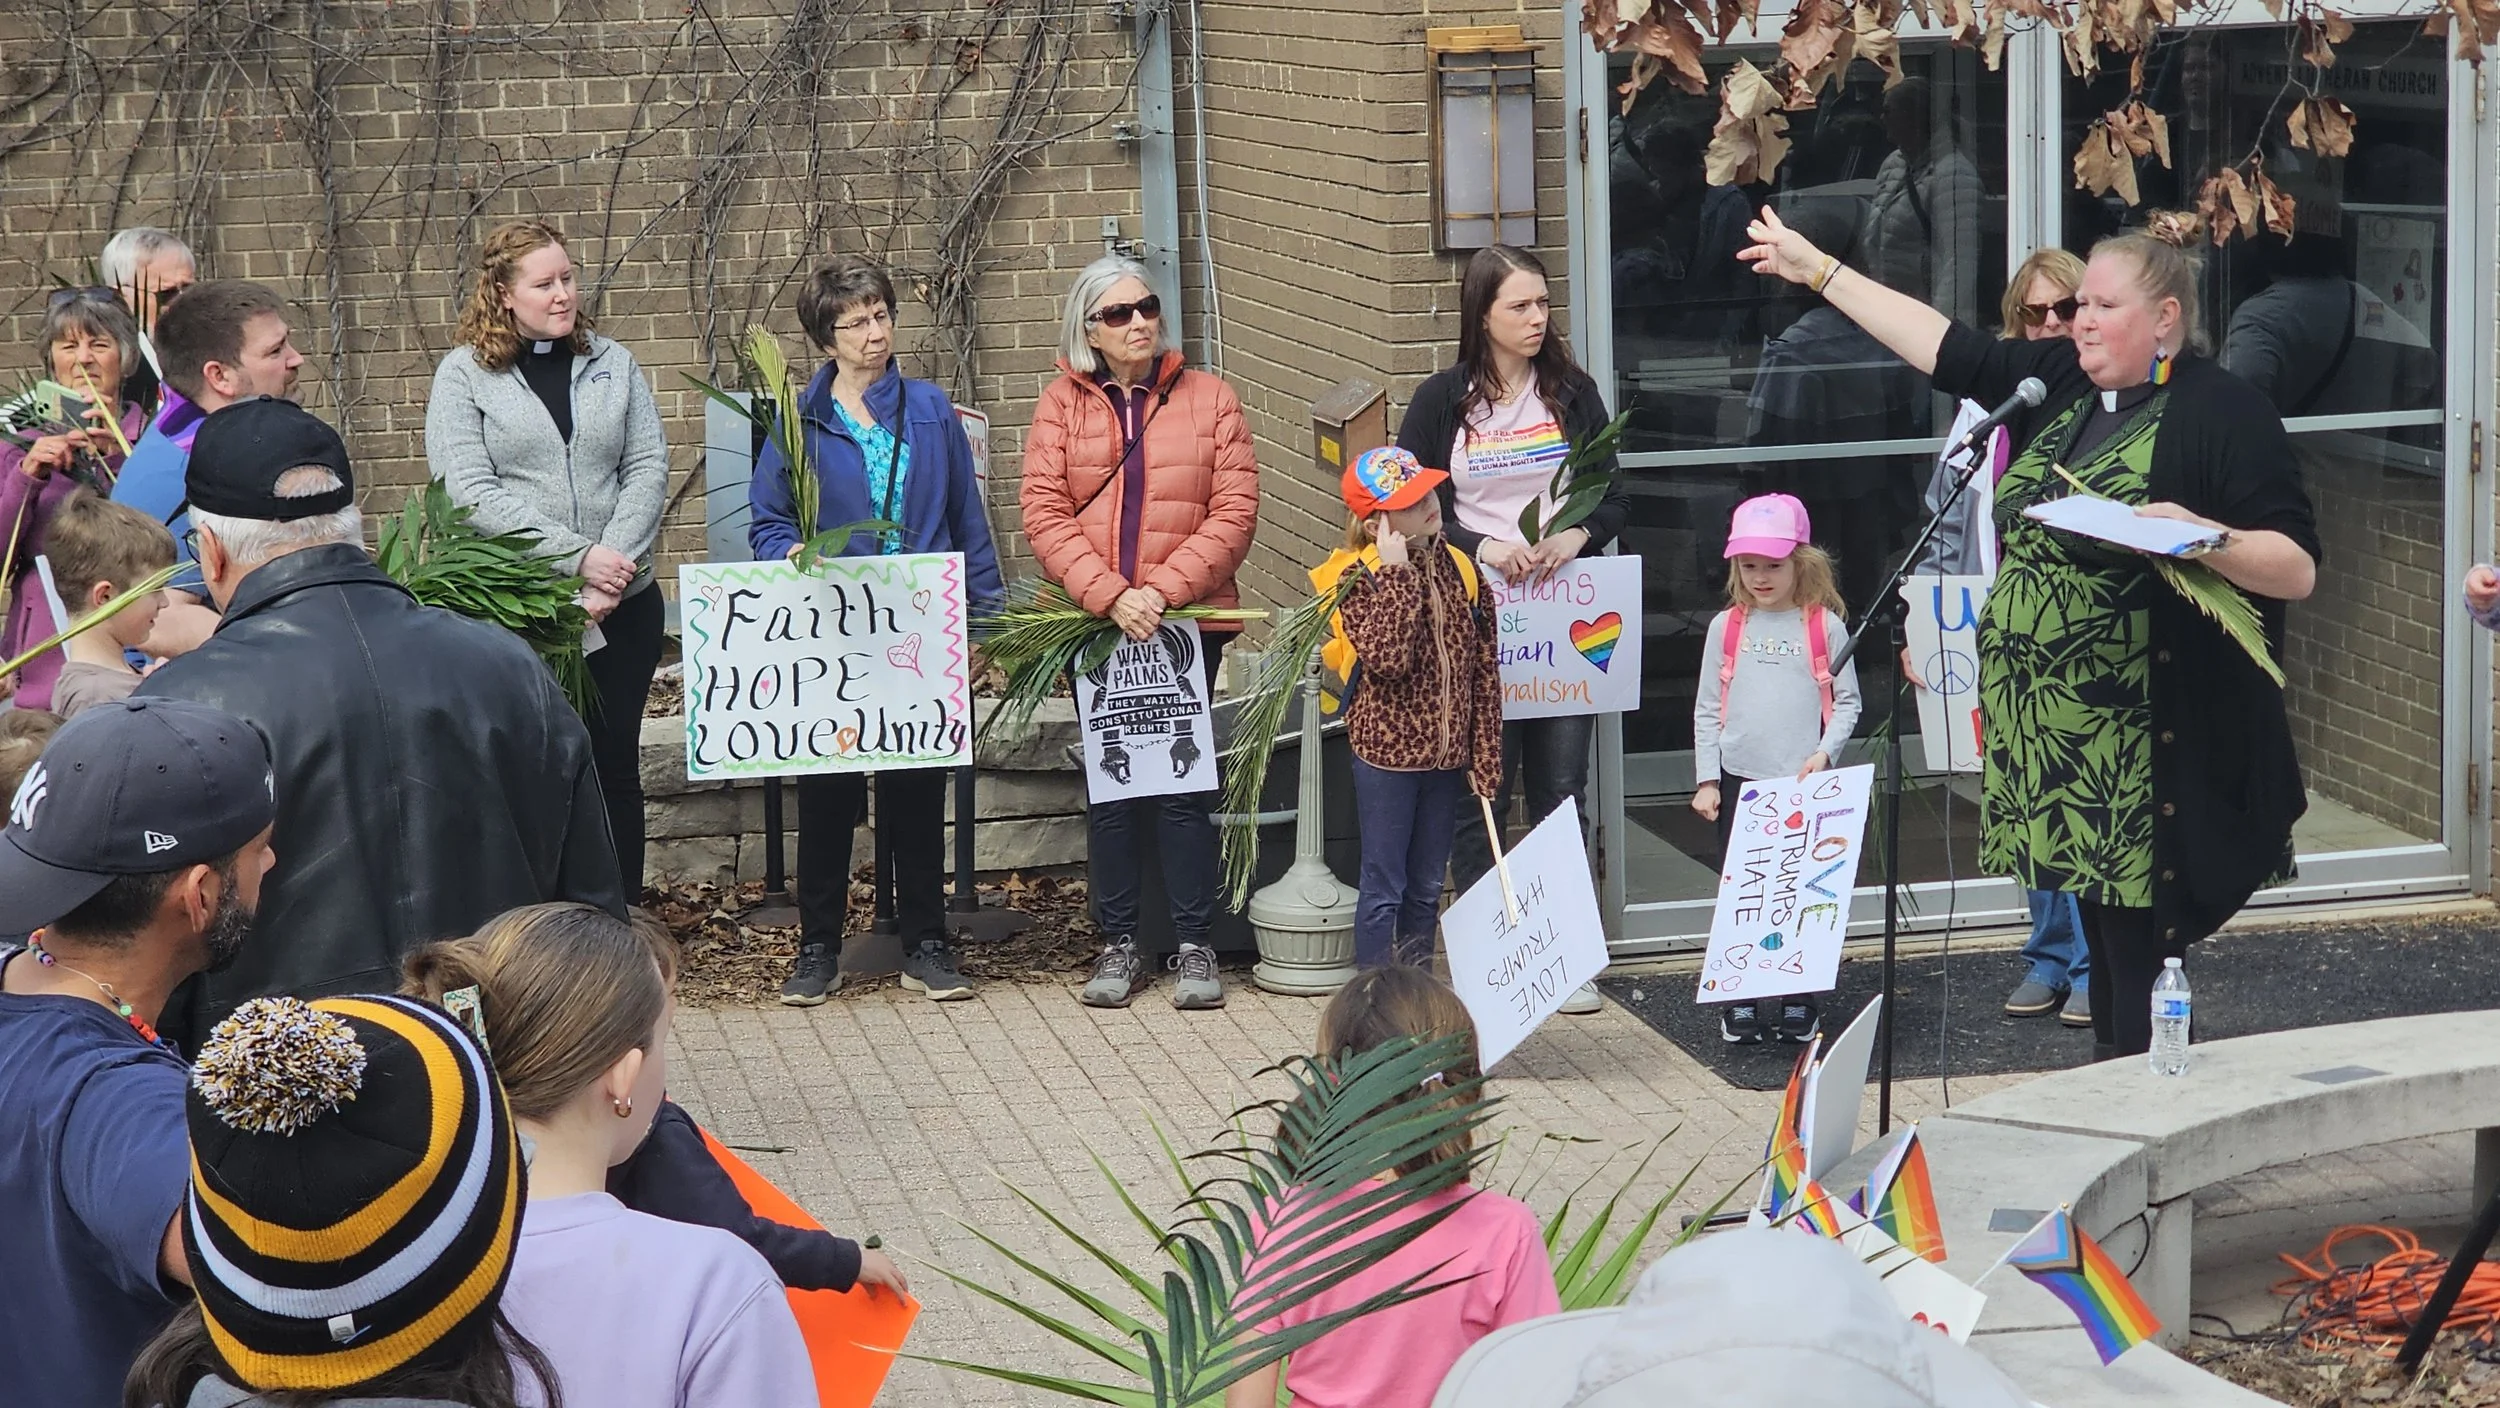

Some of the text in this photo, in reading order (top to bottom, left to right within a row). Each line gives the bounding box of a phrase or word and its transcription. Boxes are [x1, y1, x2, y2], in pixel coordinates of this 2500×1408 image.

[2378, 70, 2437, 95] CHURCH
[1468, 464, 1480, 472] ARE
[1482, 461, 1509, 471] HUMAN
[1511, 457, 1534, 467] RIGHTS
[1490, 573, 1595, 607] stians
[721, 582, 906, 651] Faith
[1115, 643, 1161, 668] WAVE
[705, 652, 873, 713] HOPE
[1113, 663, 1169, 690] PALMS
[1503, 675, 1593, 705] nalism
[1090, 704, 1202, 730] CONSTITUTIONAL
[1108, 695, 1180, 709] THEY WAIVE
[853, 698, 968, 761] Unity
[1124, 722, 1170, 734] RIGHTS
[1736, 846, 1774, 928] HATE
[1771, 820, 1811, 928] TRUMPS
[1796, 807, 1855, 937] LOVE
[1487, 917, 1560, 993] TRUMPS
[1510, 955, 1568, 1027] LOVE
